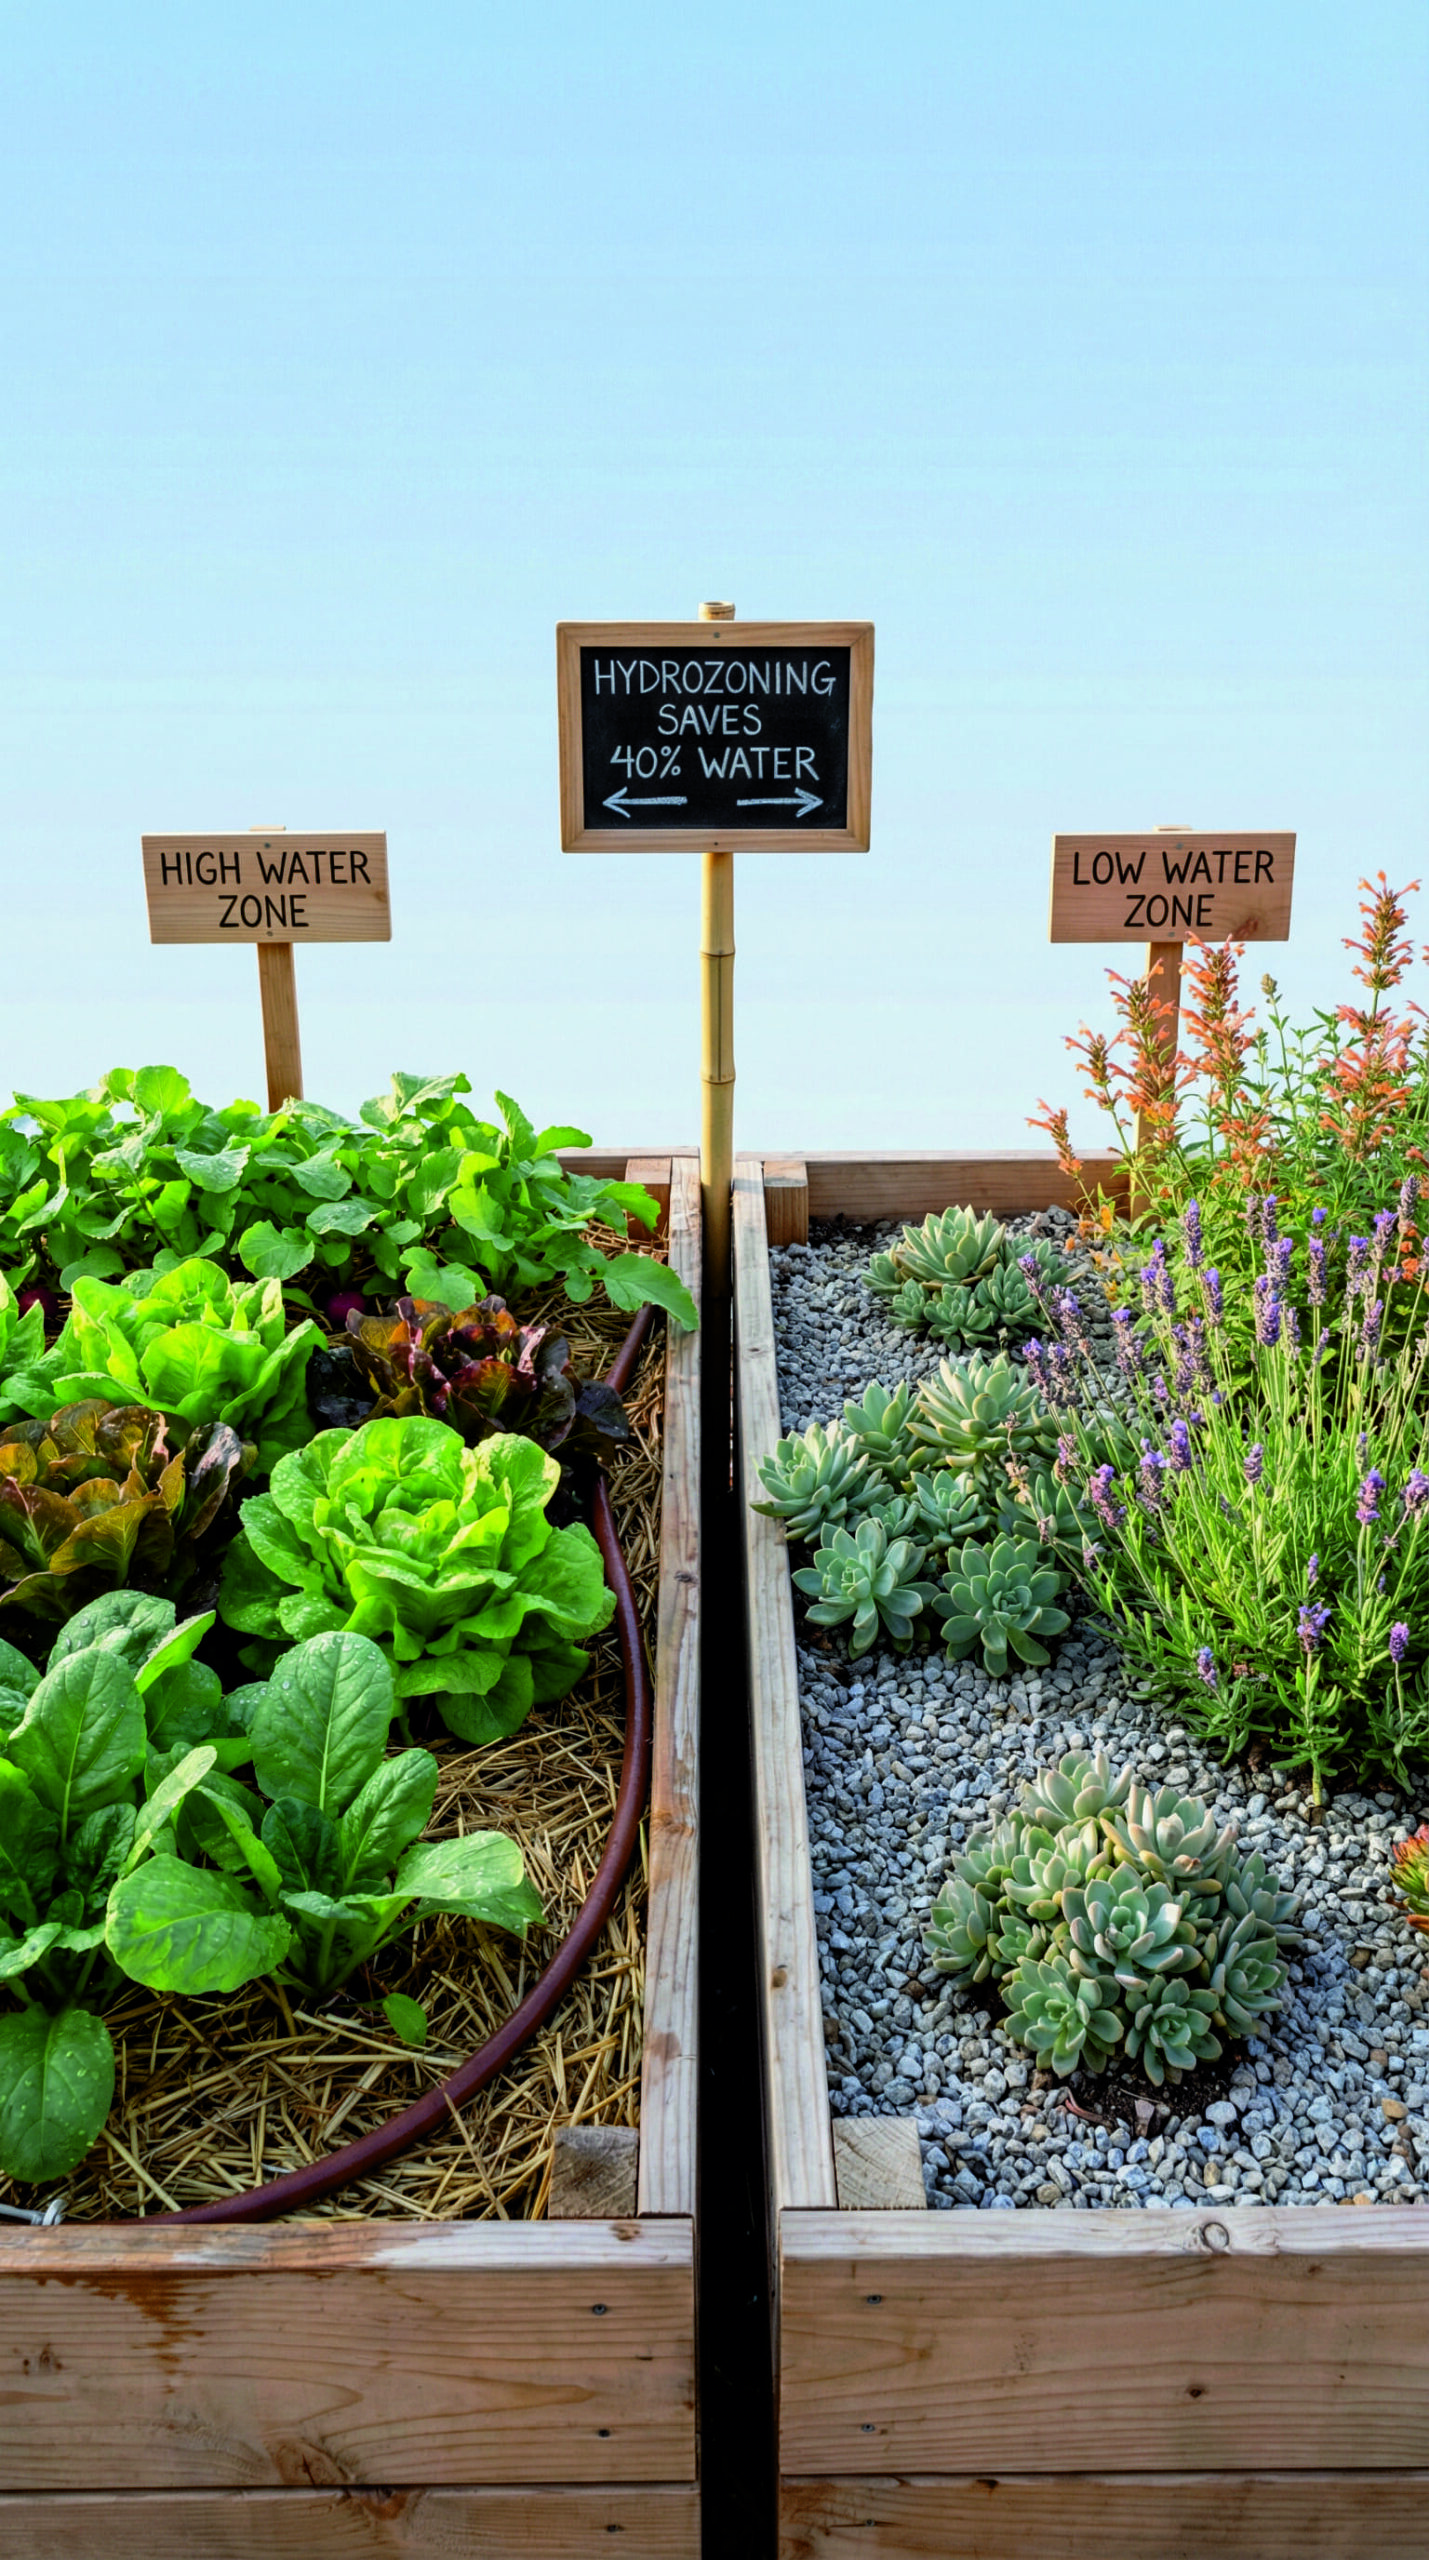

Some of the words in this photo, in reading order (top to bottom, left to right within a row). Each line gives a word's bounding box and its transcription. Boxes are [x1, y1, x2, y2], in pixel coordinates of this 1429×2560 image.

[594, 659, 837, 697] HYDROZONING
[657, 703, 762, 735] SAVES
[610, 745, 682, 779] 40%
[697, 746, 820, 781] WATER
[160, 851, 241, 885] HIGH
[256, 850, 372, 884] WATER
[1073, 851, 1146, 885] LOW
[1162, 850, 1274, 884] WATER
[218, 894, 309, 928] ZONE
[1124, 894, 1215, 927] ZONE
